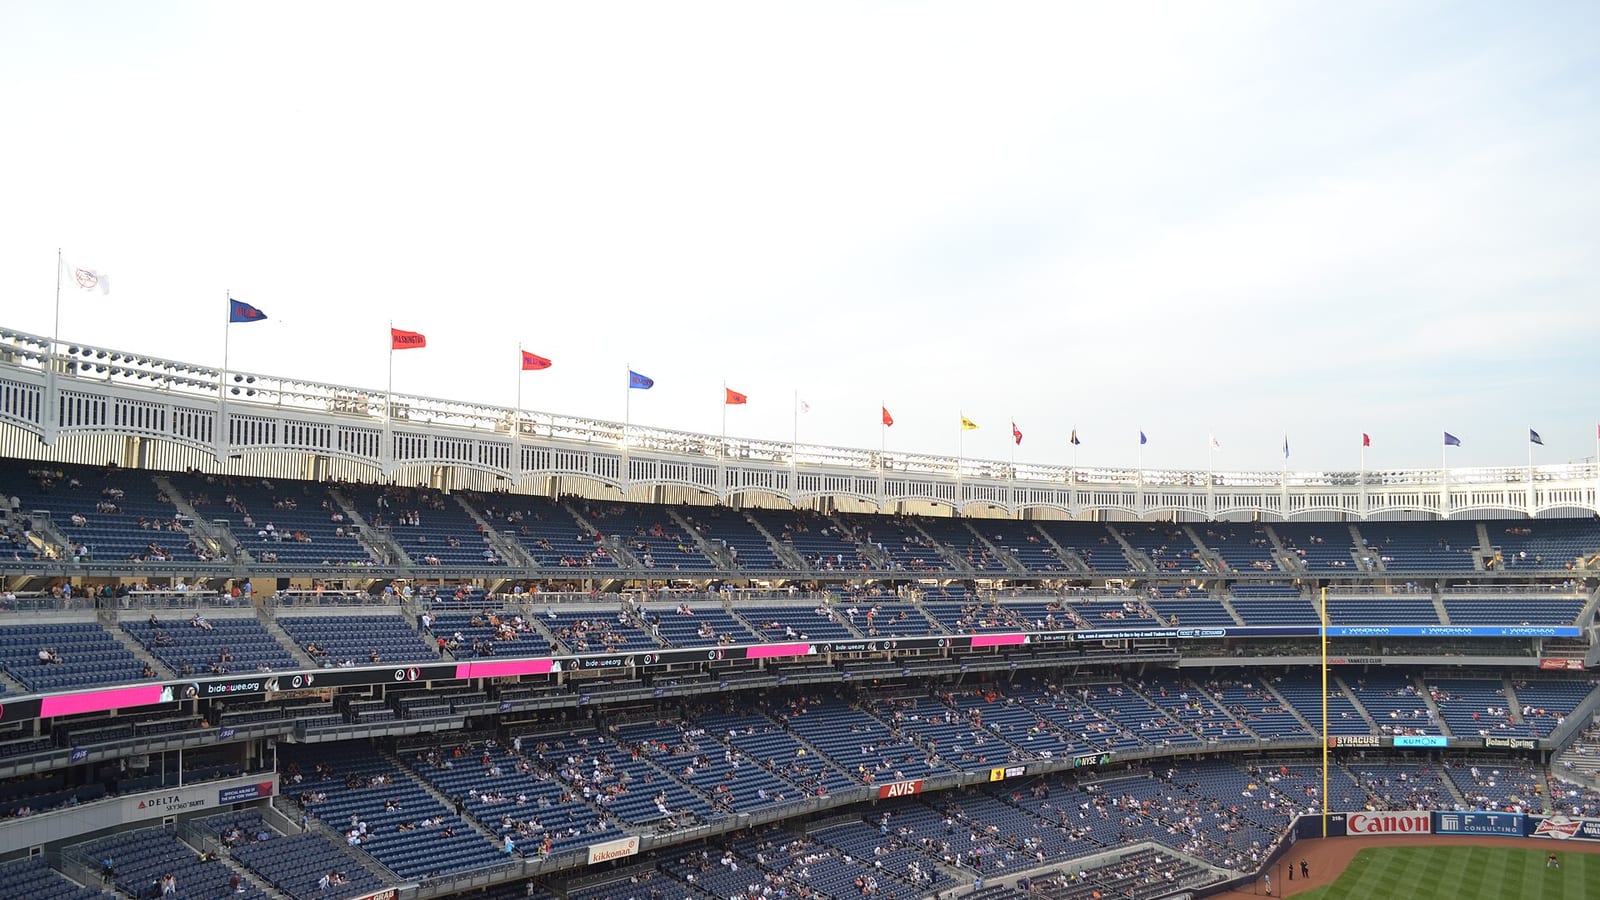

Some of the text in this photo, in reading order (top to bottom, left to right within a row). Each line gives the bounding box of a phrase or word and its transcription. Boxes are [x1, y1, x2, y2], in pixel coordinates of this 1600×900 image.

[1337, 736, 1380, 745] SYRACUSE
[1403, 738, 1437, 746] KUMON
[1486, 738, 1535, 749] Poland Spring
[1081, 755, 1097, 767] NYSE
[887, 781, 916, 798] AVIS
[149, 795, 180, 807] DELTA
[1348, 814, 1430, 833] Canon
[1464, 825, 1518, 833] CONSULTING
[592, 848, 633, 862] kikkoman
